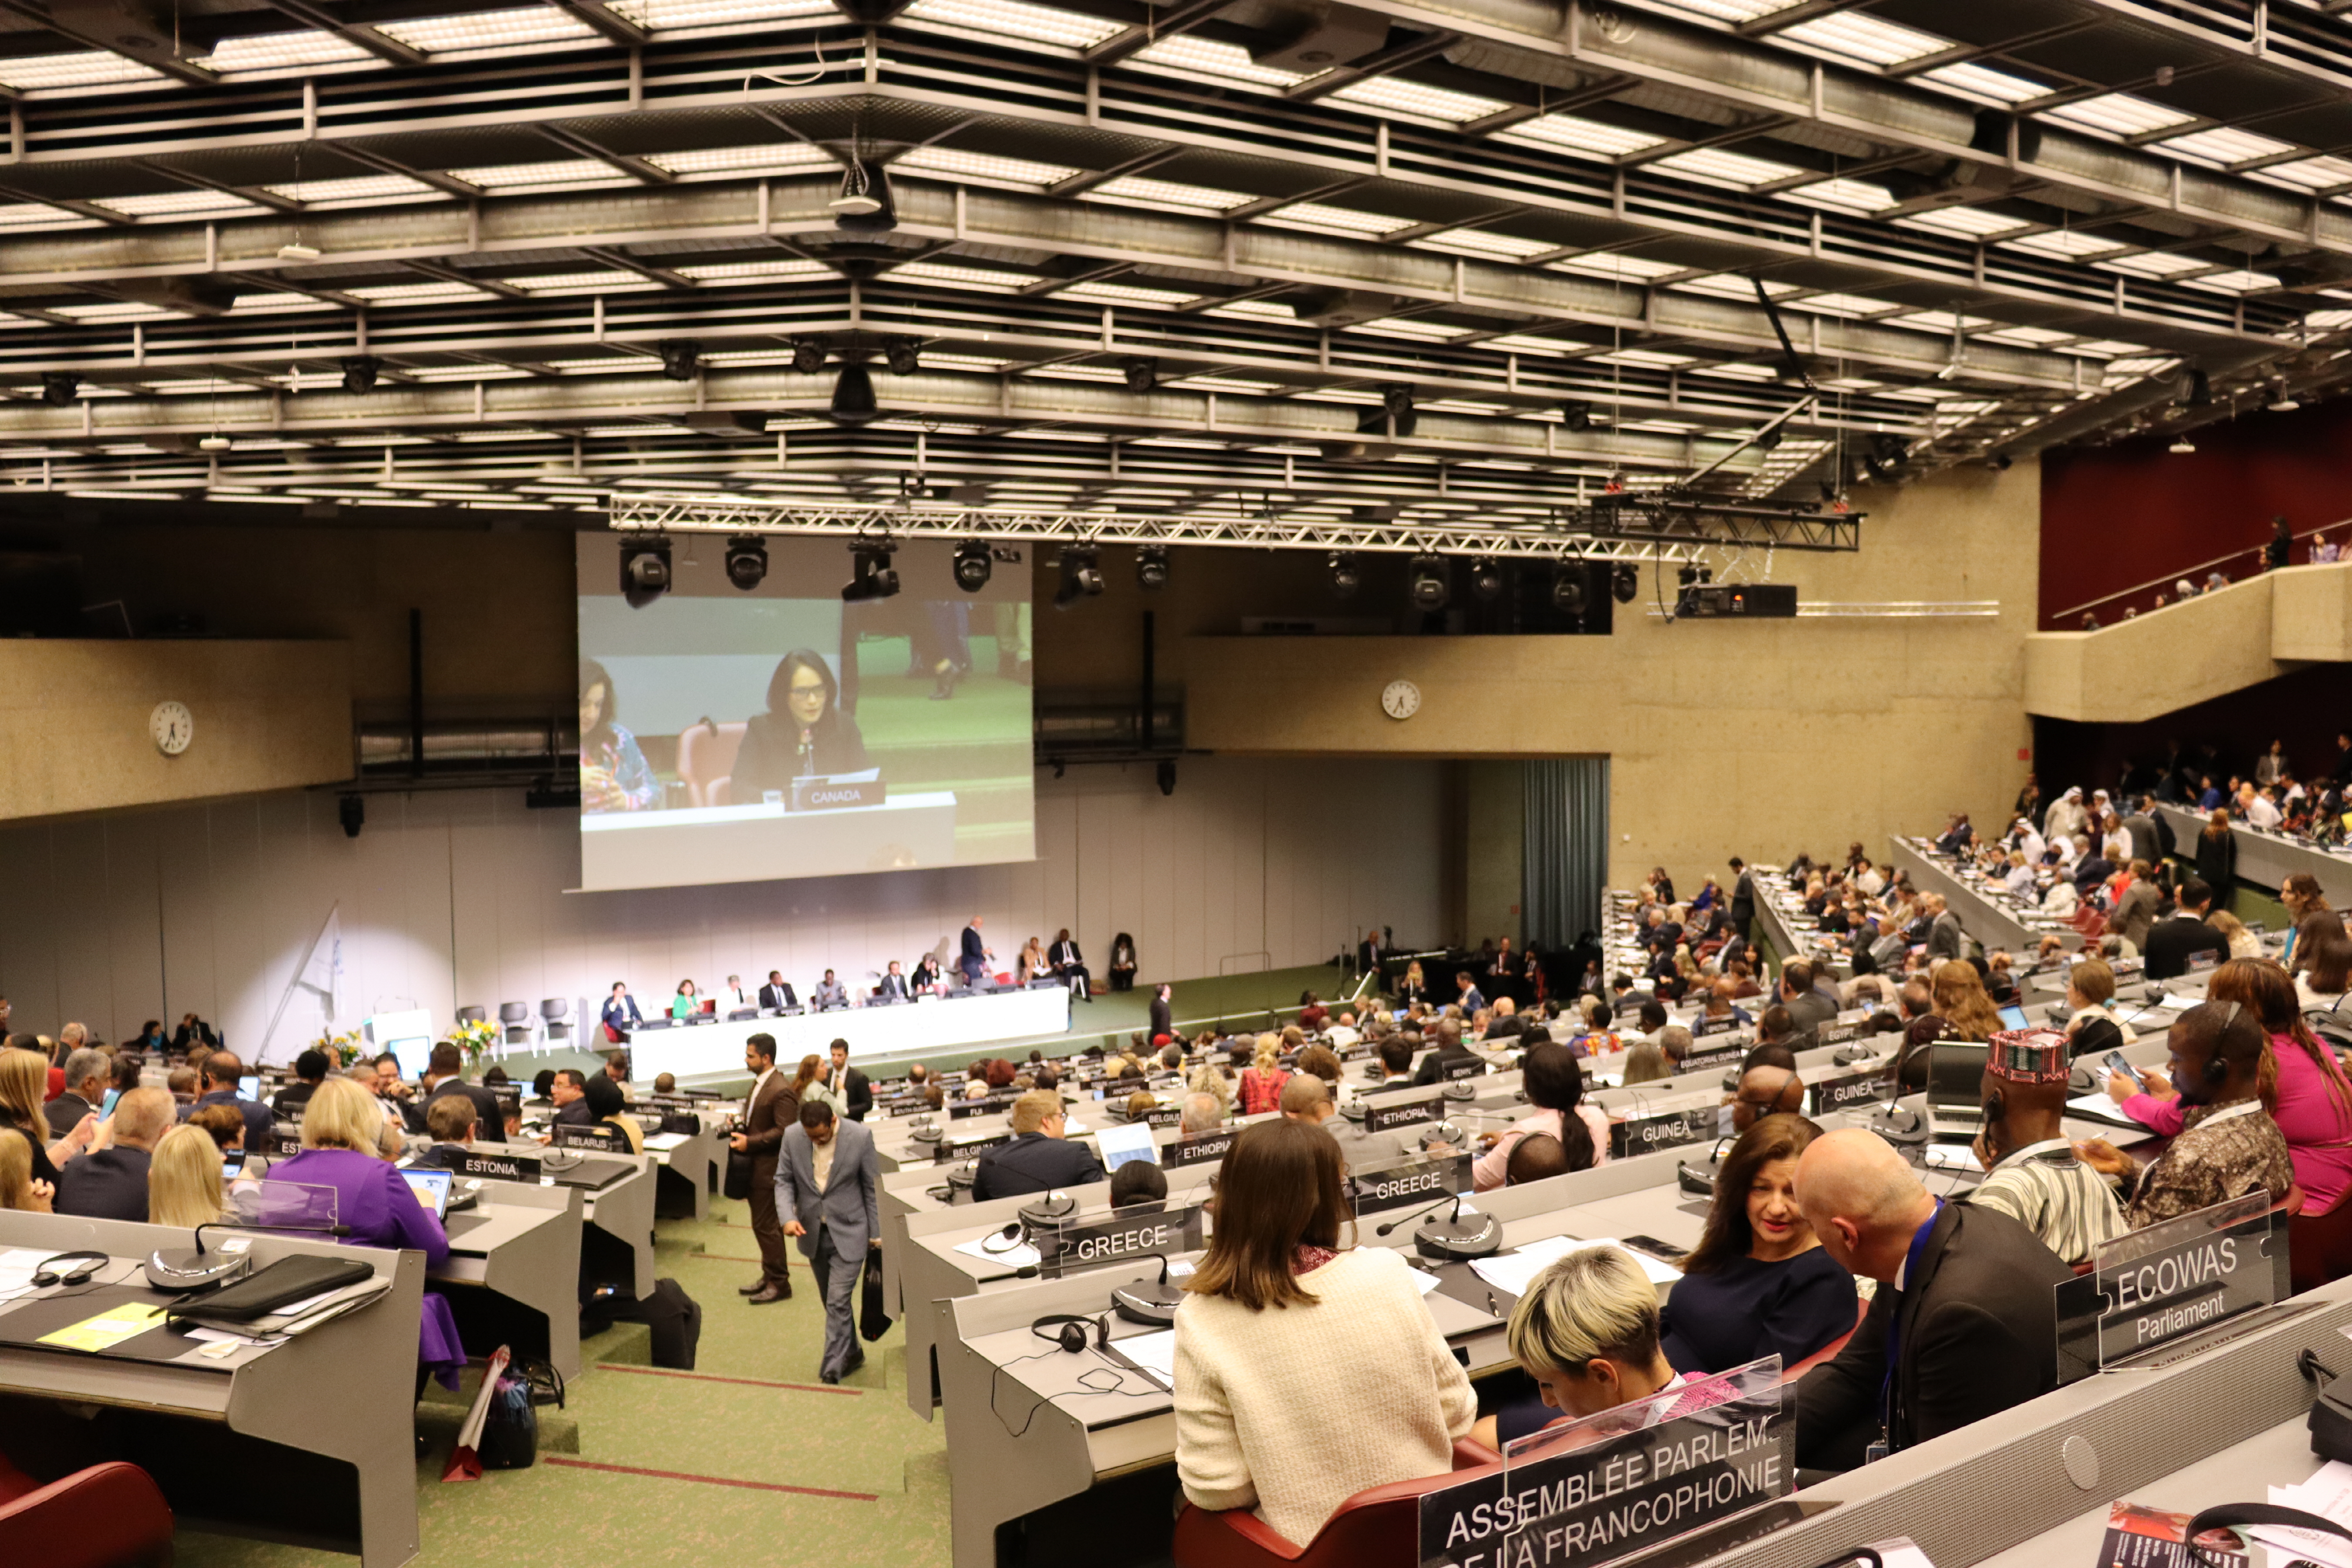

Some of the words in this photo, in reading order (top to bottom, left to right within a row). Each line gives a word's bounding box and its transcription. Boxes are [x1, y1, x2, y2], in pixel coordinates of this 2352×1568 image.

[811, 790, 861, 804] CANADA
[1828, 1027, 1854, 1041] EGYPT
[1680, 1056, 1717, 1068] EQUATORIAL
[1718, 1050, 1740, 1061] GUINEA
[1834, 1081, 1873, 1102] GUINEA
[635, 1105, 662, 1114] ALGERIA
[970, 1108, 983, 1116] FIJI
[1383, 1106, 1428, 1125] ETHIOPIA
[1642, 1120, 1691, 1142] GUINEA
[568, 1136, 606, 1149] BELARUS
[466, 1159, 517, 1175] ESTONIA
[1376, 1171, 1441, 1200] GREECE
[1078, 1224, 1168, 1260] GREECE
[2118, 1237, 2237, 1310] ECOWAS
[2137, 1291, 2224, 1344] Parliament
[1446, 1454, 1644, 1549] ASSEMBLÉE
[1545, 1454, 1781, 1565] FRANCOPHONIE
